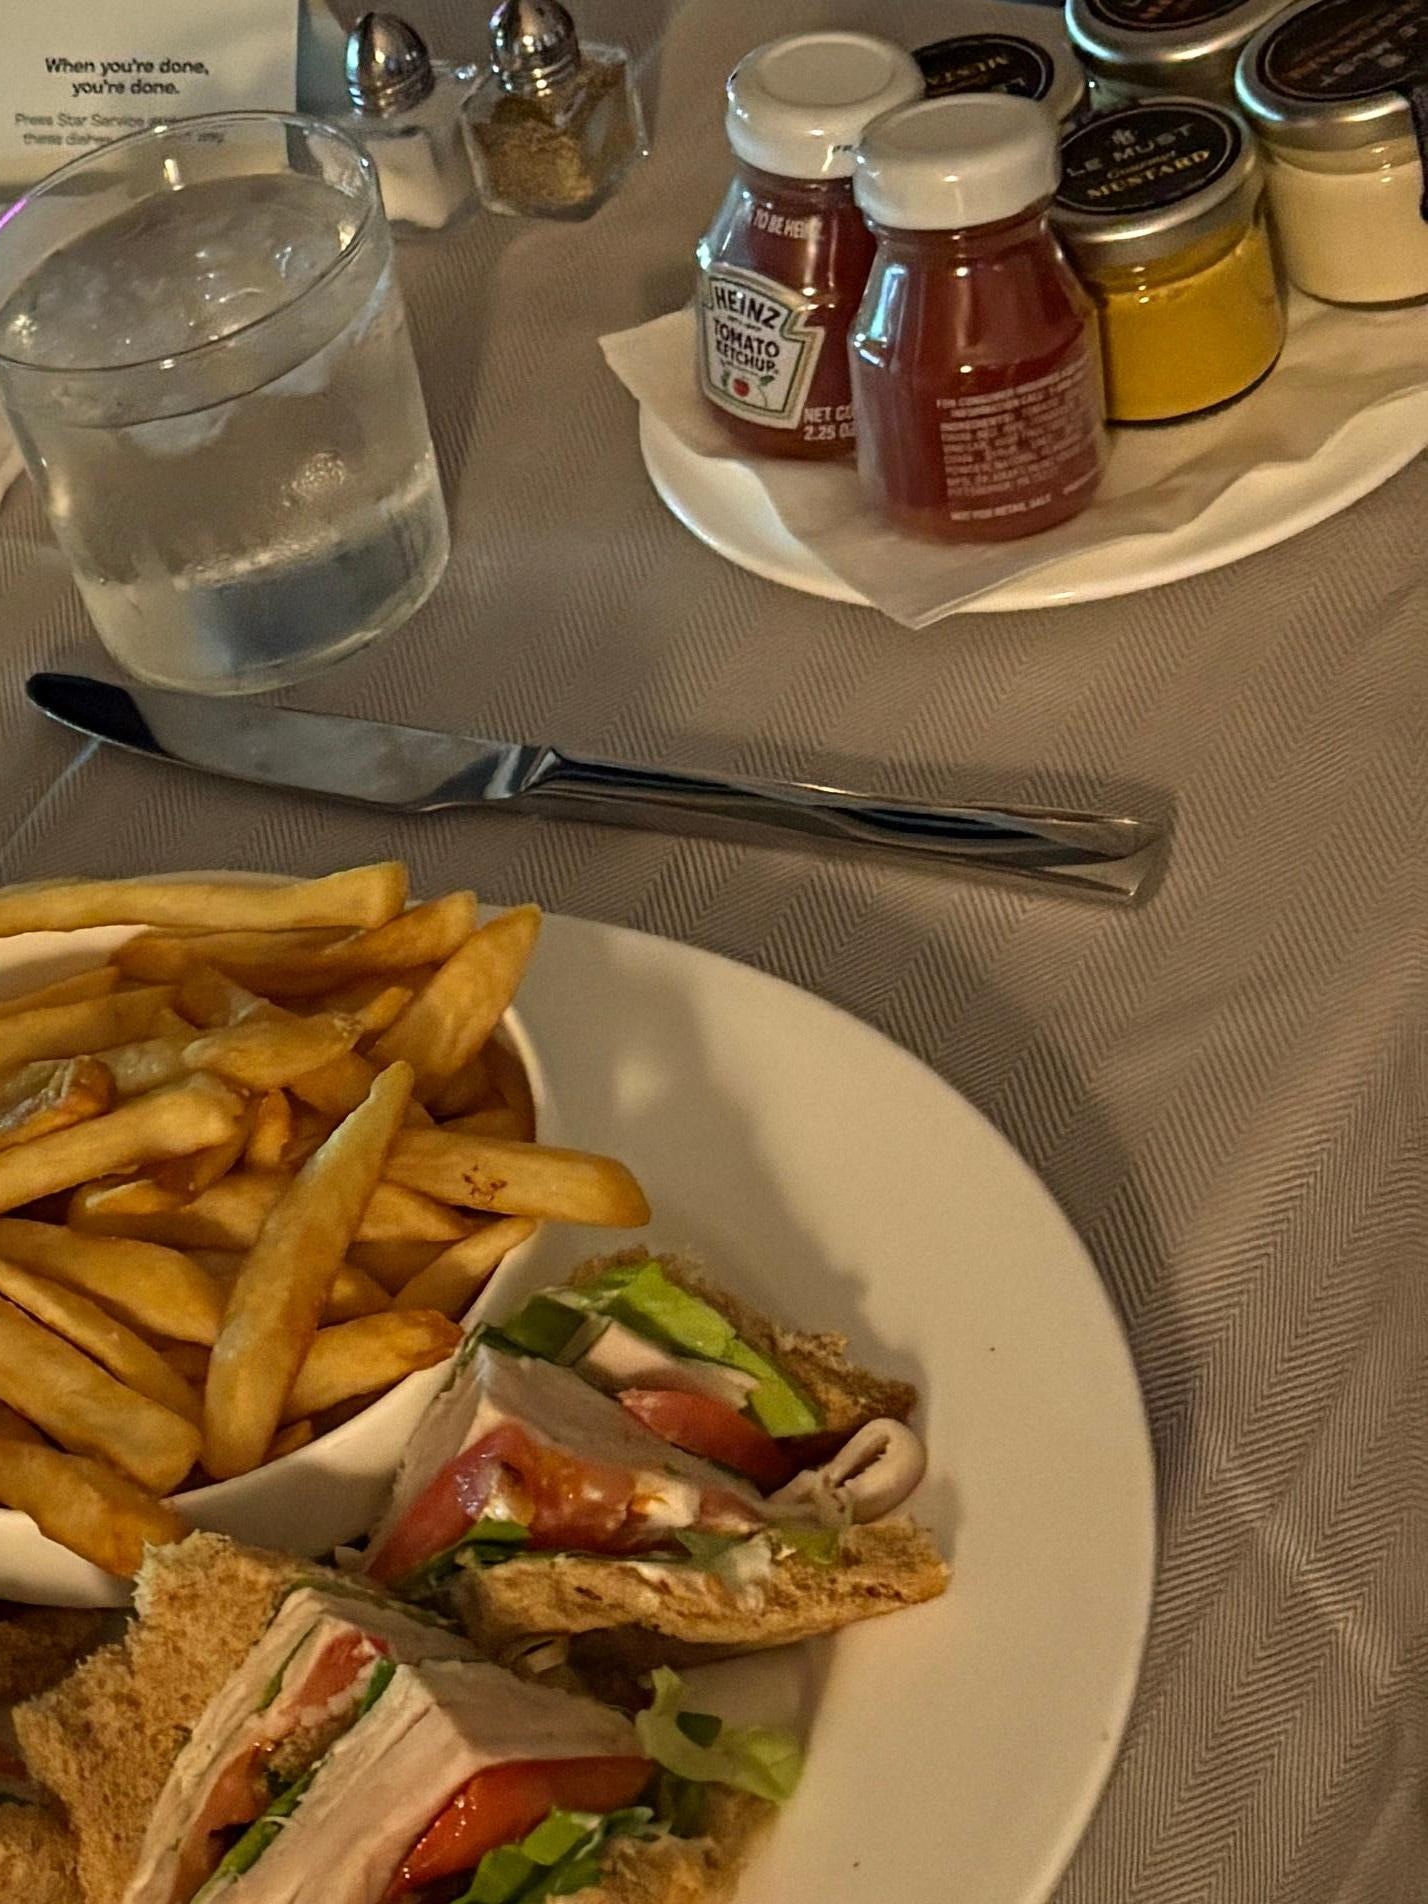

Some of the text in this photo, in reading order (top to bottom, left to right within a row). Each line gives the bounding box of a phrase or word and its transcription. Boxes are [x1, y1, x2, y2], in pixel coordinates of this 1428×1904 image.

[45, 57, 210, 76] When you're done,
[71, 79, 181, 97] you're done.
[57, 112, 88, 127] Star
[1112, 122, 1194, 163] MUST
[1086, 148, 1211, 198] MUSTARD
[768, 213, 784, 235] BE
[714, 285, 782, 330] HEINZ
[712, 317, 781, 359] TOMATO
[716, 339, 776, 374] KETCHUP
[802, 406, 833, 424] NET
[803, 424, 836, 442] 2.25
